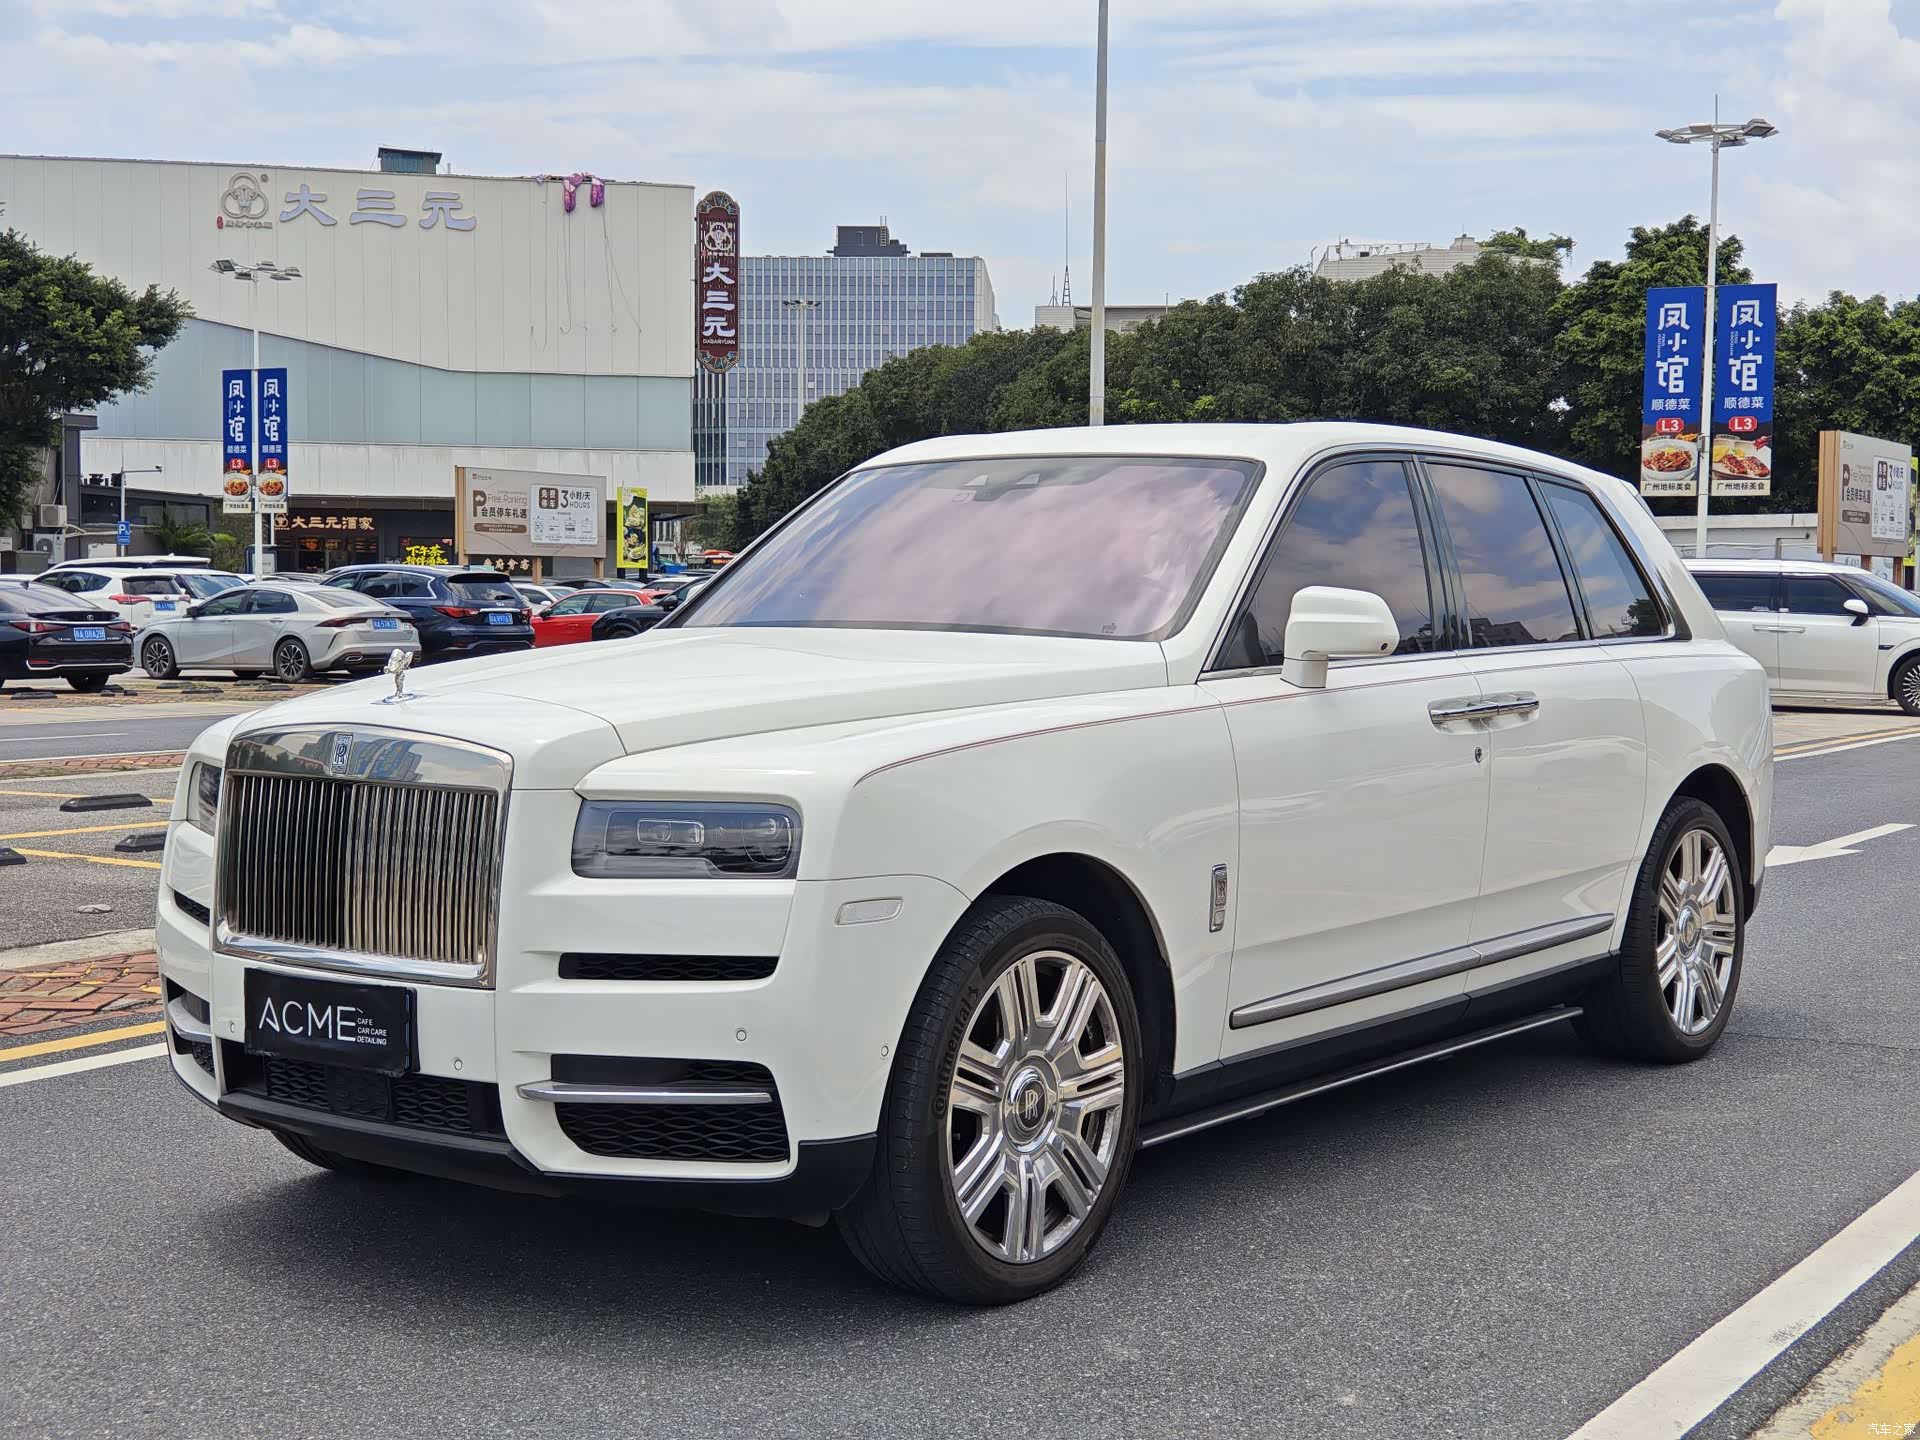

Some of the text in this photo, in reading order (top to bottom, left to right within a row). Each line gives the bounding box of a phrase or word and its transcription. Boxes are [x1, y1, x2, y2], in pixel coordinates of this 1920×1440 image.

[279, 184, 477, 232] 大三元
[702, 262, 736, 337] 大三元
[1656, 302, 1691, 394] 凤小馆
[1729, 299, 1764, 391] 凤小馆
[1651, 398, 1691, 411] 顺德菜
[1724, 396, 1765, 410] 顺德菜
[228, 379, 246, 442] 凤小馆
[263, 378, 281, 442] 凤小馆
[1661, 419, 1679, 432] L3
[1734, 417, 1753, 430] L3
[231, 460, 241, 469] L3
[266, 460, 277, 469] L3
[1644, 482, 1692, 491] 广州地标美食
[1716, 481, 1765, 491] 广州地标美食
[560, 489, 569, 509] 3
[290, 515, 375, 531] 大三元酒家
[405, 544, 446, 557] 下午茶
[357, 1017, 373, 1026] CAFE
[357, 1026, 388, 1037] CAR CARE
[356, 1035, 388, 1046] DETAILING
